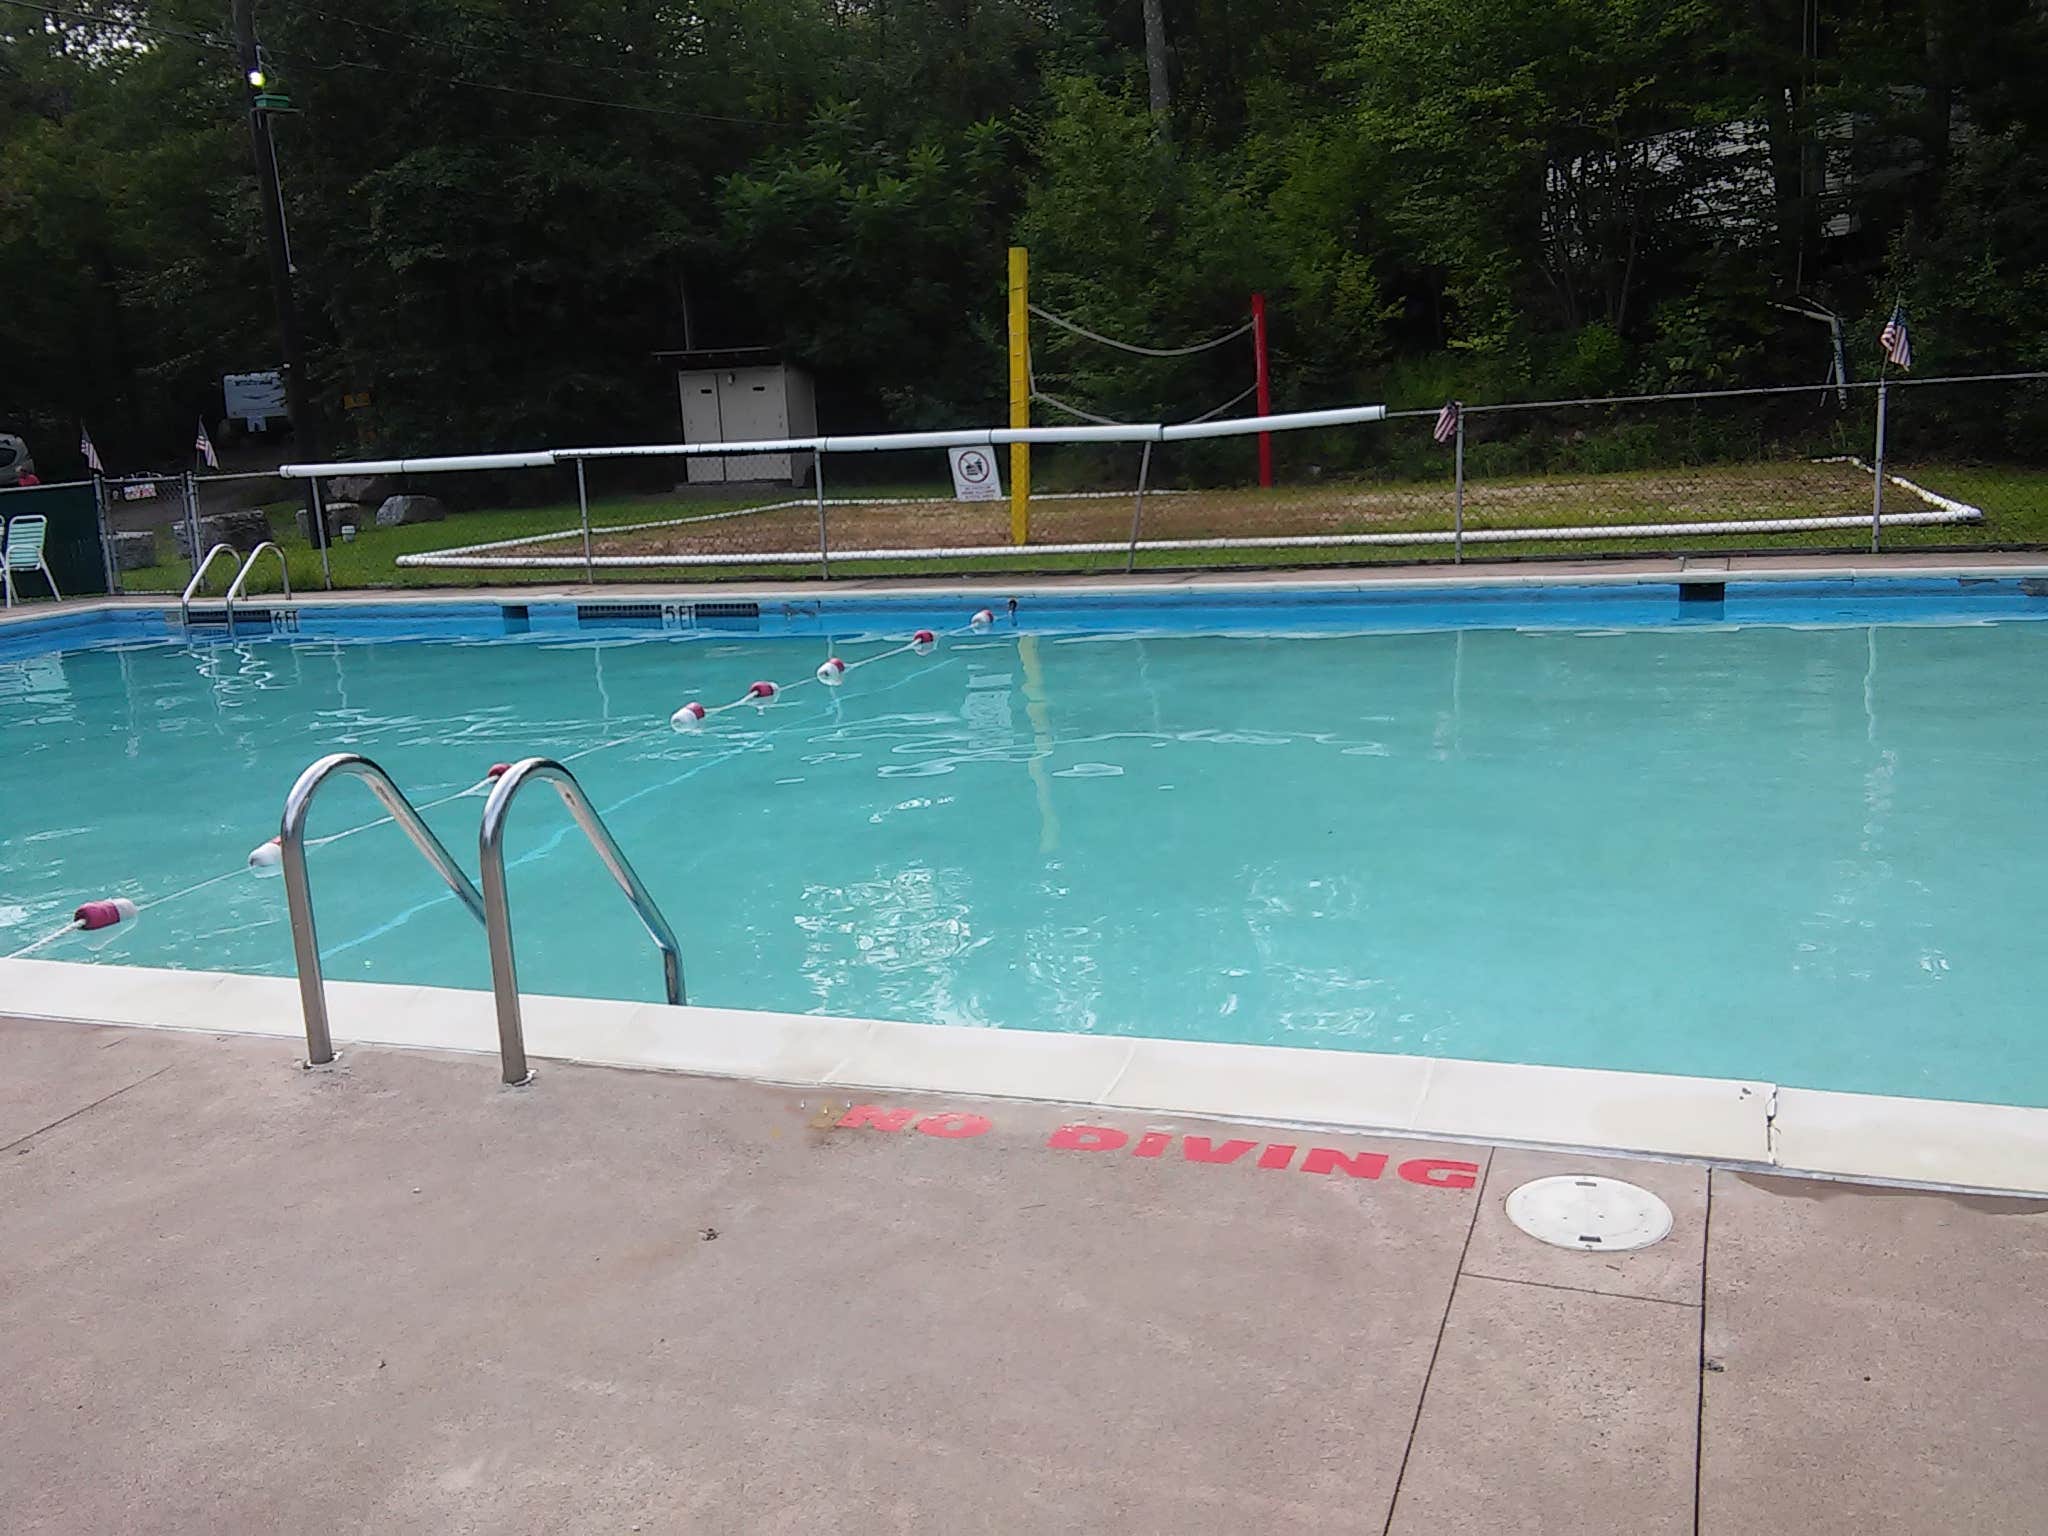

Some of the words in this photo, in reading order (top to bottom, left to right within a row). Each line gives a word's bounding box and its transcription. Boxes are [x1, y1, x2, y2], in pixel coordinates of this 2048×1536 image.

[665, 605, 676, 622] 5
[678, 605, 695, 623] FT
[836, 1104, 993, 1139] NO
[1046, 1124, 1480, 1189] DIVING
